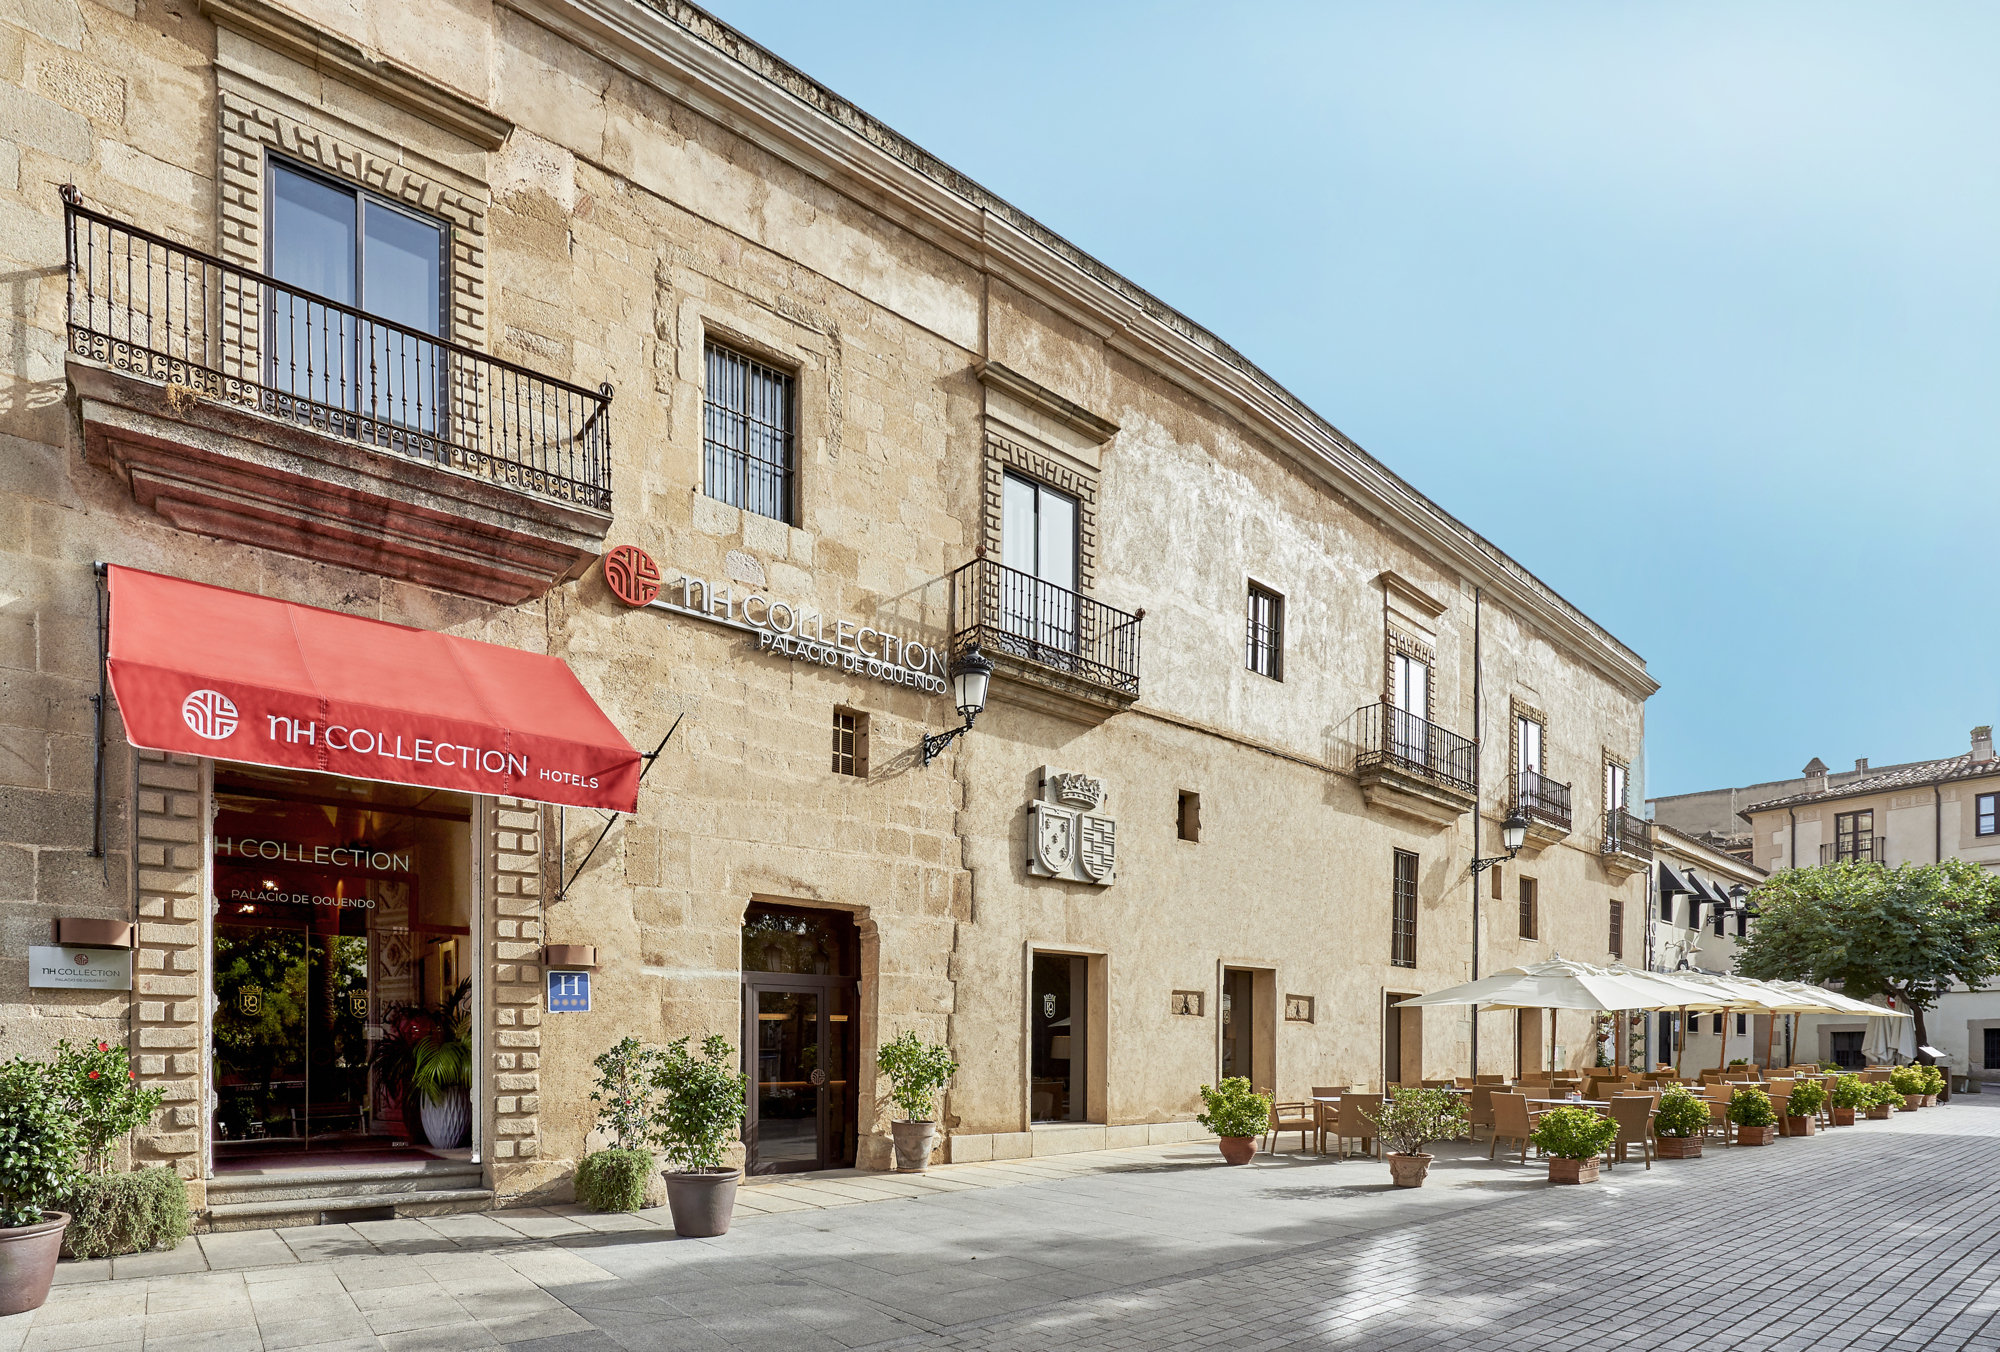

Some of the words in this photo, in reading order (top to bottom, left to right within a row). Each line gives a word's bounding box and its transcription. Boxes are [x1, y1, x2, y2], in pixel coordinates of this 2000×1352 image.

[741, 594, 947, 677] COLLECTION
[759, 631, 837, 665] PALACIO
[842, 654, 864, 673] DE
[867, 662, 947, 694] OQUENDO
[325, 725, 528, 777] COLLECTION
[539, 768, 599, 789] HOTELS
[239, 838, 409, 872] COLLECTION
[231, 889, 289, 902] PALACIO
[292, 894, 309, 905] DE
[312, 896, 376, 909] OQUENDO
[58, 968, 120, 977] COLLECTION
[558, 975, 581, 996] H
